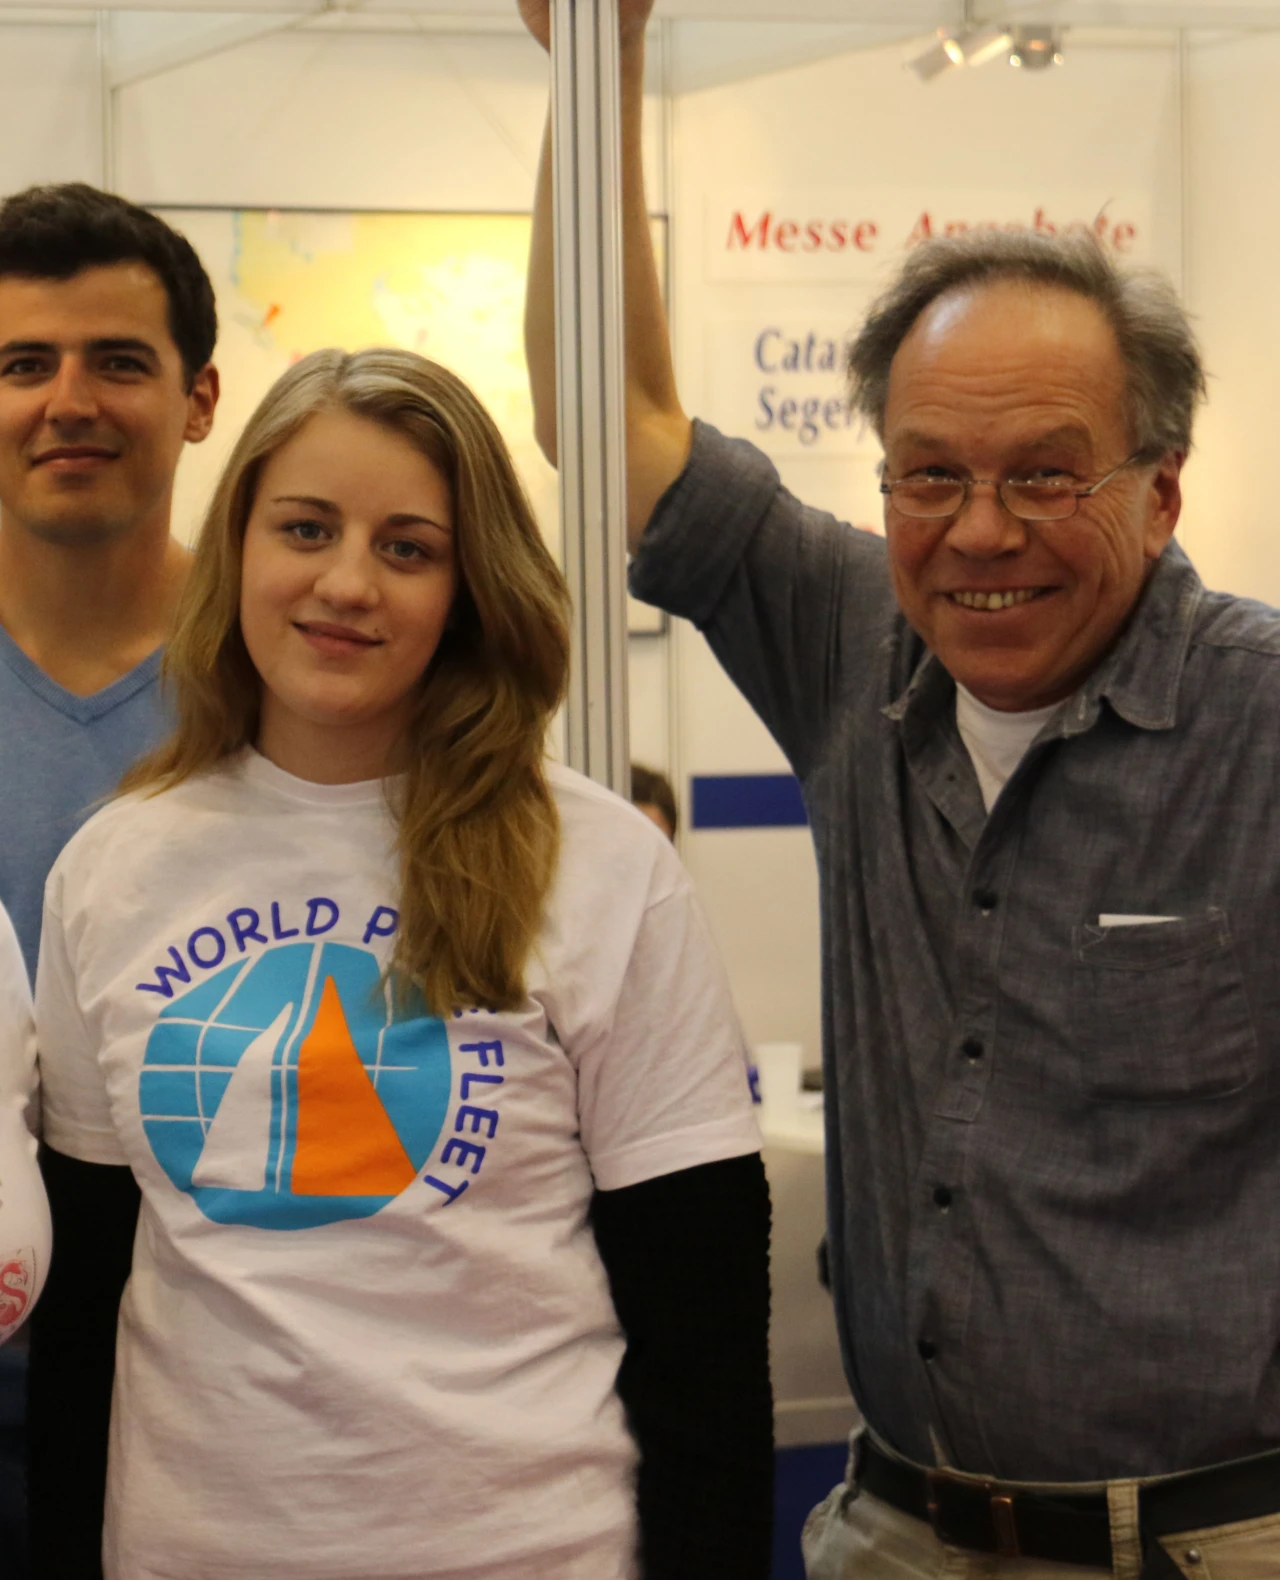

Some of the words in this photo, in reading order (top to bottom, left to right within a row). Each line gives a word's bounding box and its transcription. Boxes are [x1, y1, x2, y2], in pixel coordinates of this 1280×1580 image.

[726, 210, 878, 253] Messe
[754, 326, 848, 374] Cata
[135, 897, 340, 998] WORLD
[424, 1040, 505, 1207] FLEET
